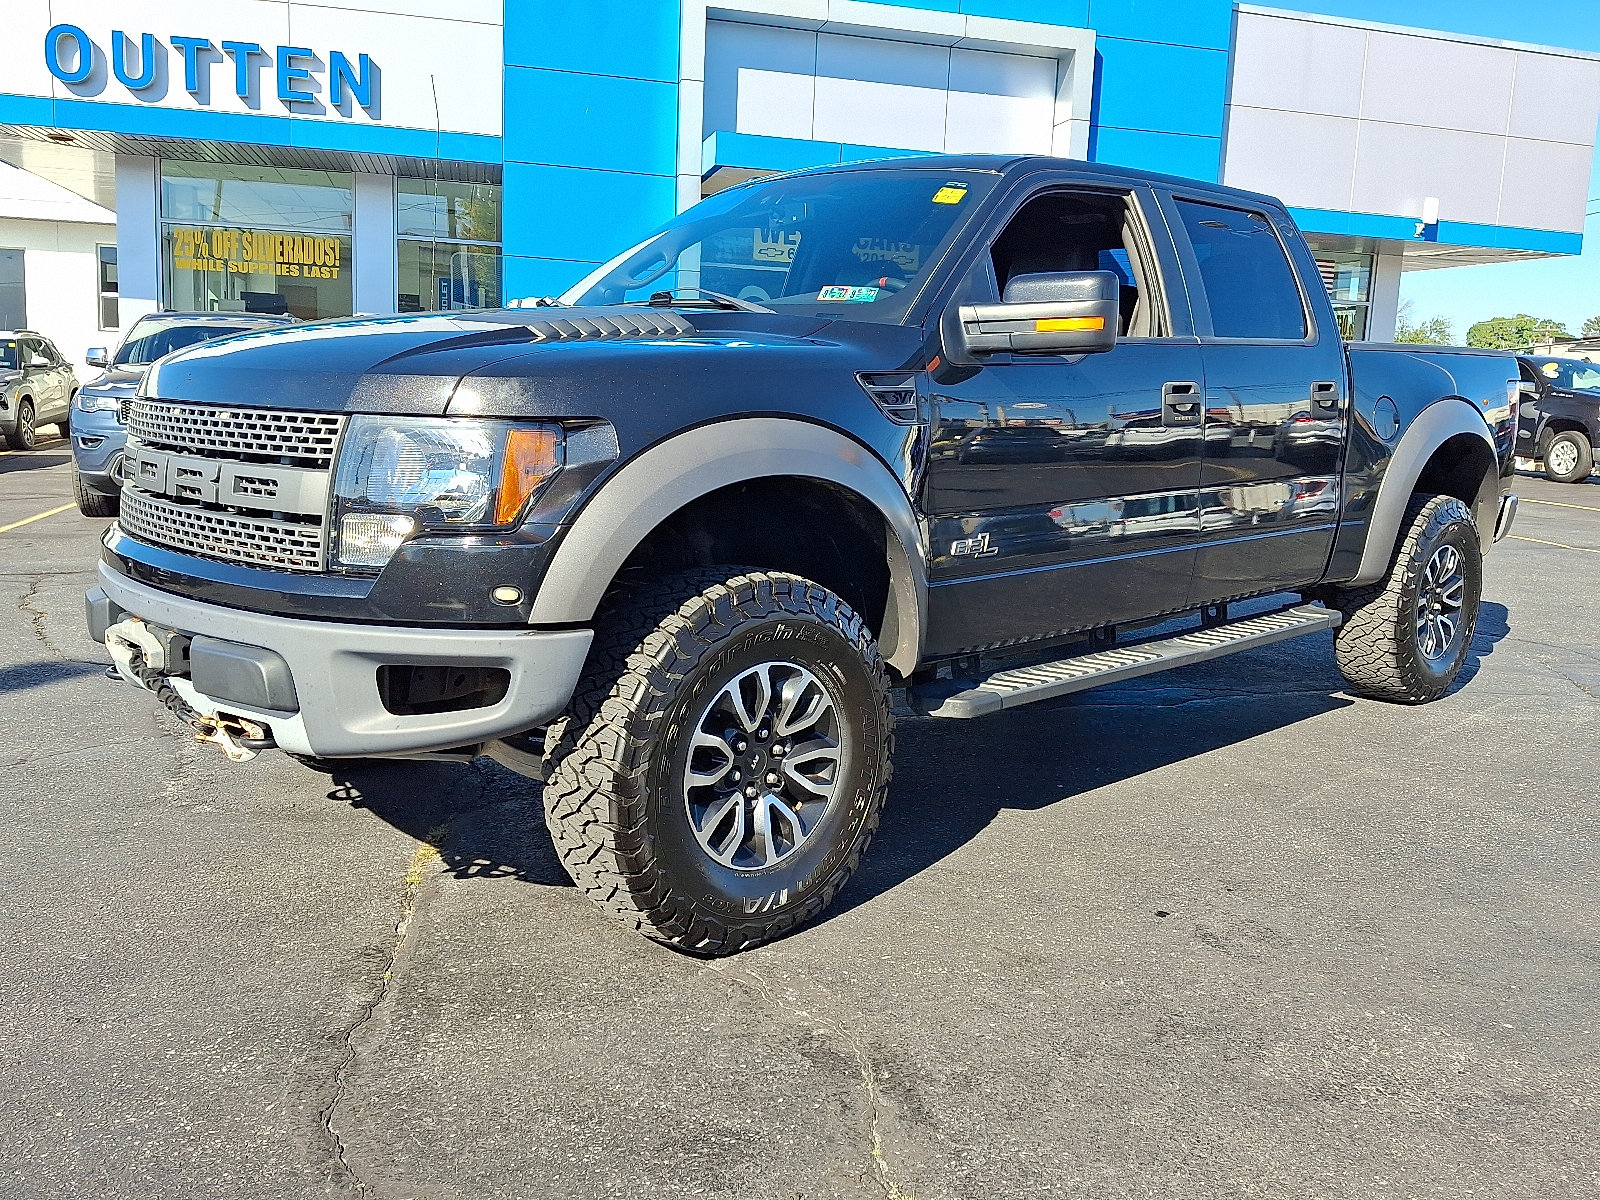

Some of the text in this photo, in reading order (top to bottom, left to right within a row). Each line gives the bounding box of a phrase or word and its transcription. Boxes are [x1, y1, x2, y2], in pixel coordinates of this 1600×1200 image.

[44, 23, 371, 107] OUTTEN
[173, 227, 340, 267] 25% OFF SILVERADOS!
[174, 257, 340, 279] WHILE SUPPLIES LAST
